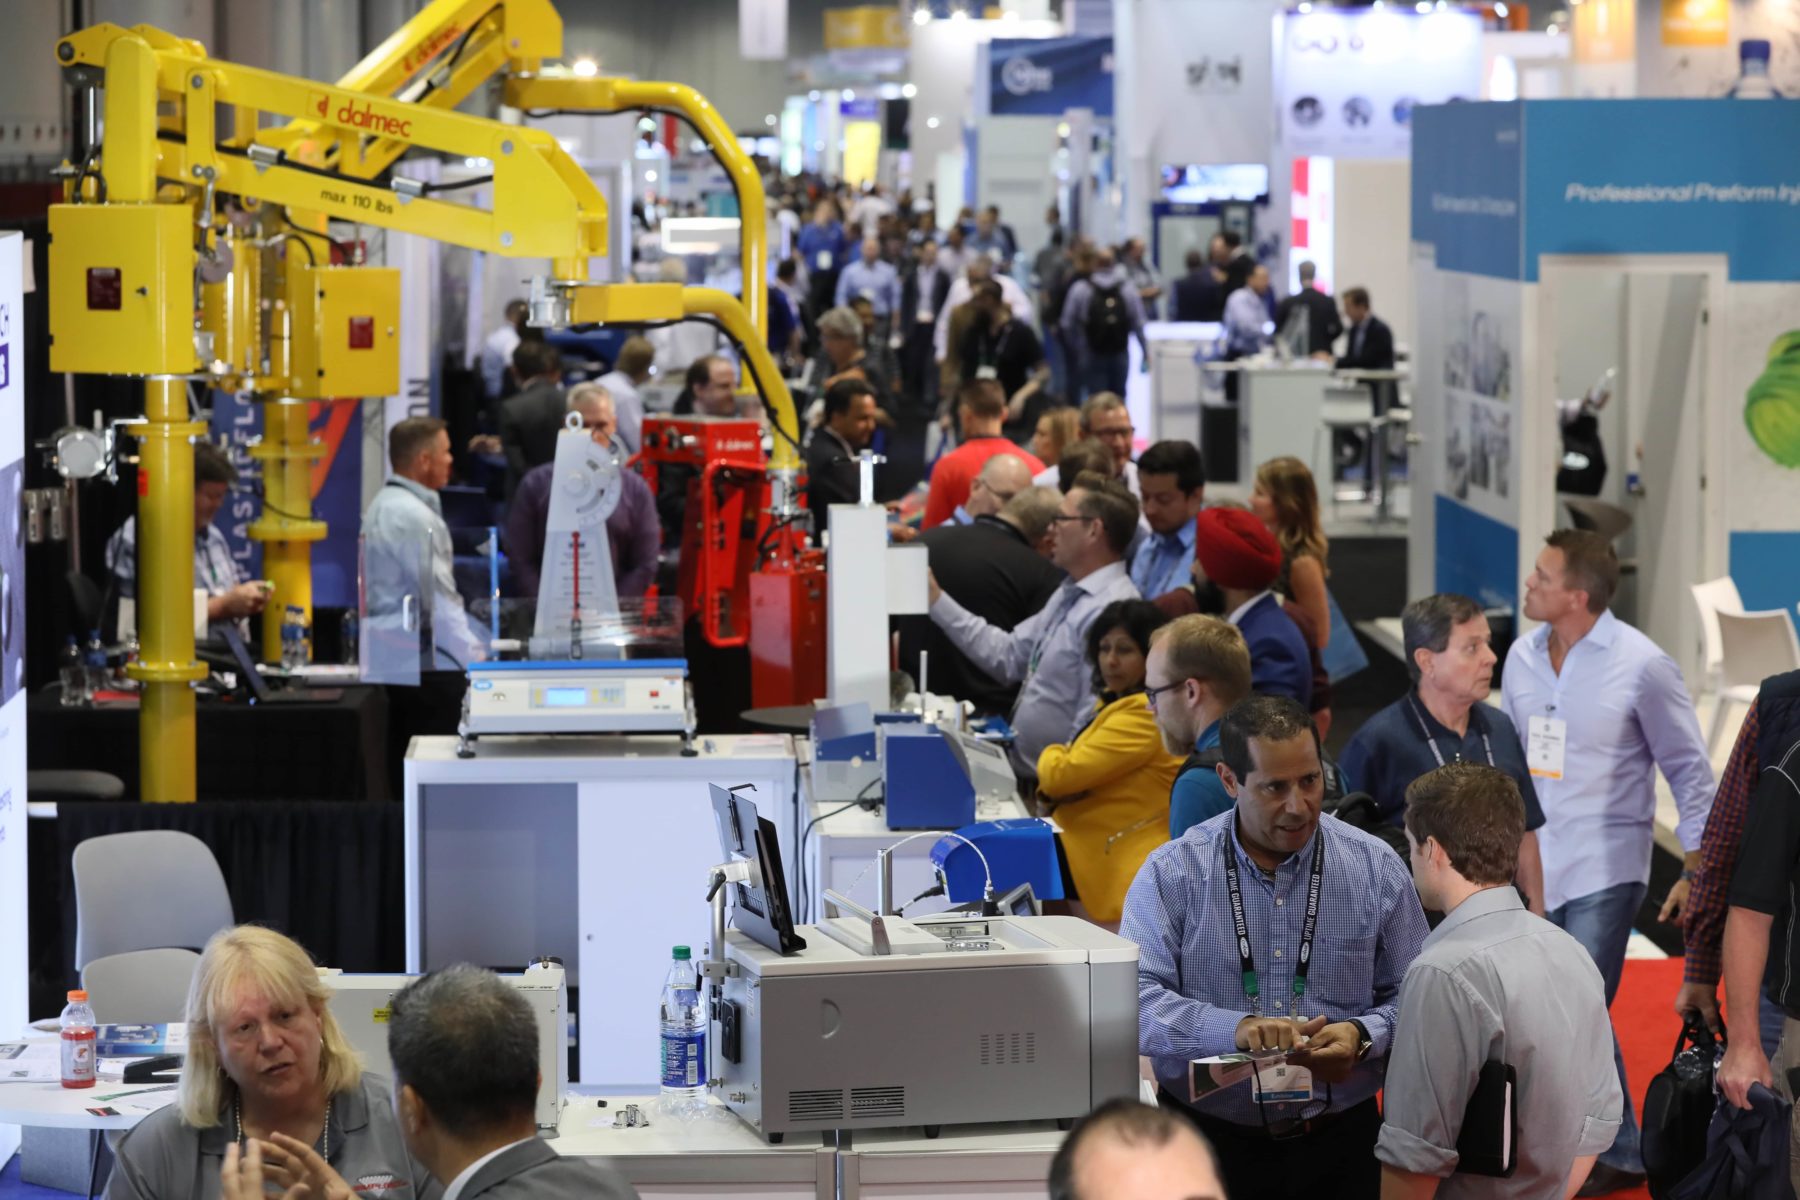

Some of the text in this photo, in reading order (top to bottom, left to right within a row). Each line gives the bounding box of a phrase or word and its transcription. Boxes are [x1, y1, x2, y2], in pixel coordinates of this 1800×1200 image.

[337, 98, 412, 138] dalmec
[321, 190, 393, 215] max 110 lbs
[1564, 181, 1694, 202] Professional
[1694, 181, 1776, 202] Preform
[1227, 868, 1239, 892] UPTIME
[1307, 874, 1320, 916] GUARANTEED
[1231, 892, 1246, 936] GUARANTEED
[1303, 916, 1315, 940] UPTIME
